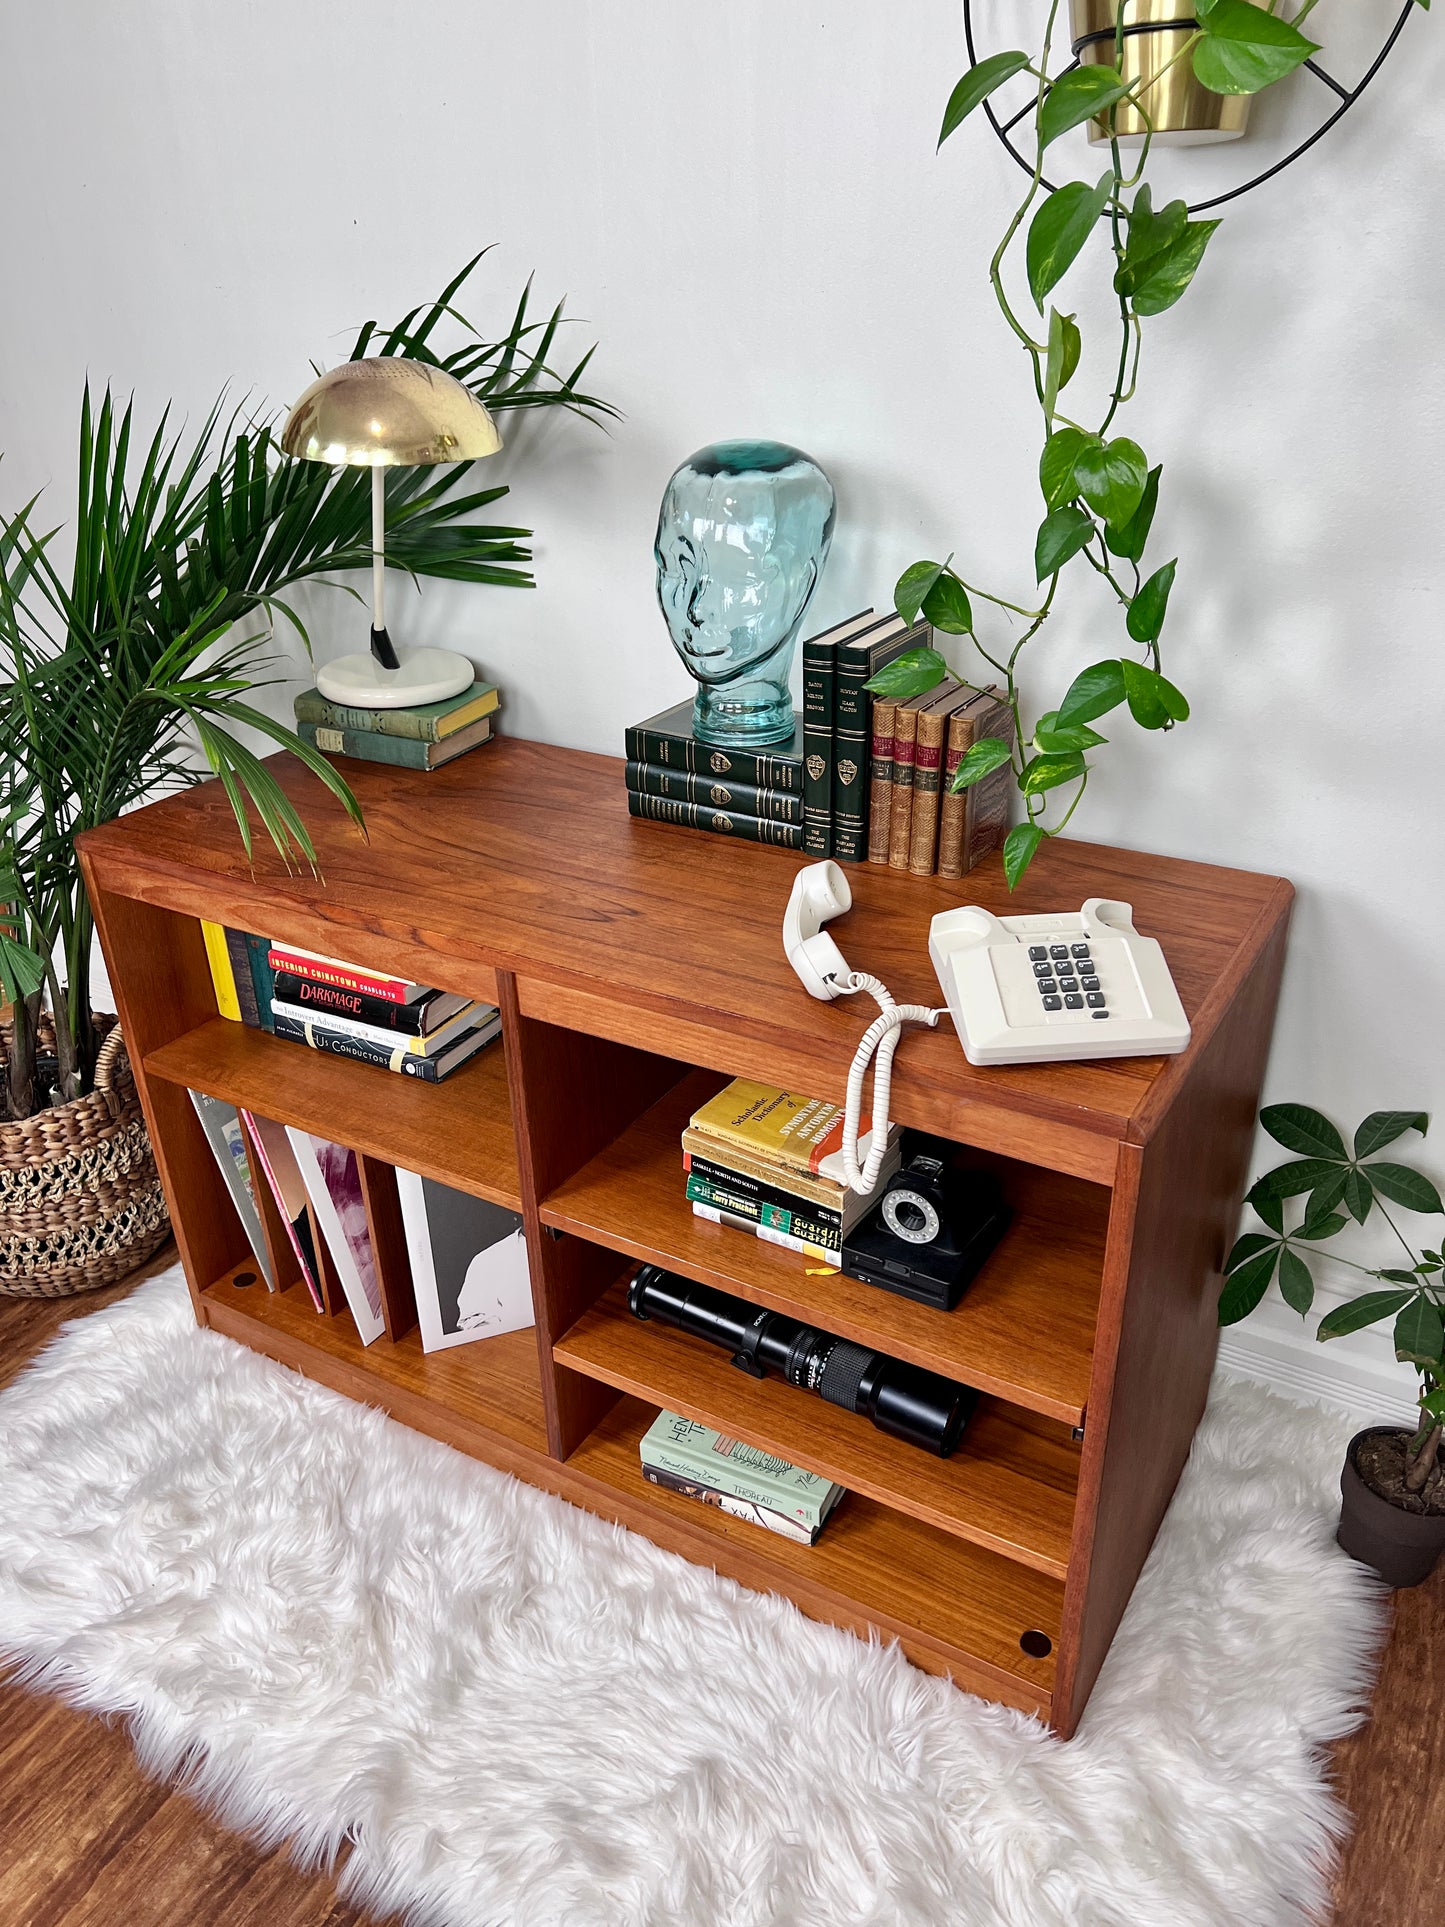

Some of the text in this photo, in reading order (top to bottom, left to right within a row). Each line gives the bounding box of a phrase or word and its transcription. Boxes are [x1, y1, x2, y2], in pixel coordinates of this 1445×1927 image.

[271, 957, 396, 999] INTERIOR CHINATOWN CHARLES YU
[300, 983, 362, 1014] DARKMAGE
[284, 1006, 315, 1022] Introvert
[316, 1016, 353, 1034] Advantage
[731, 1097, 768, 1126] Scholastic
[752, 1091, 790, 1122] Dictionary
[787, 1100, 797, 1108] of
[692, 1161, 712, 1173] GASKELL
[714, 1170, 731, 1181] NORTH
[731, 1177, 742, 1185] AND
[741, 1180, 759, 1191] SOUTH
[712, 1192, 729, 1206] Terry
[793, 1226, 838, 1249] Guards!
[794, 1217, 839, 1240] Guards!
[734, 1485, 773, 1506] THOREAU
